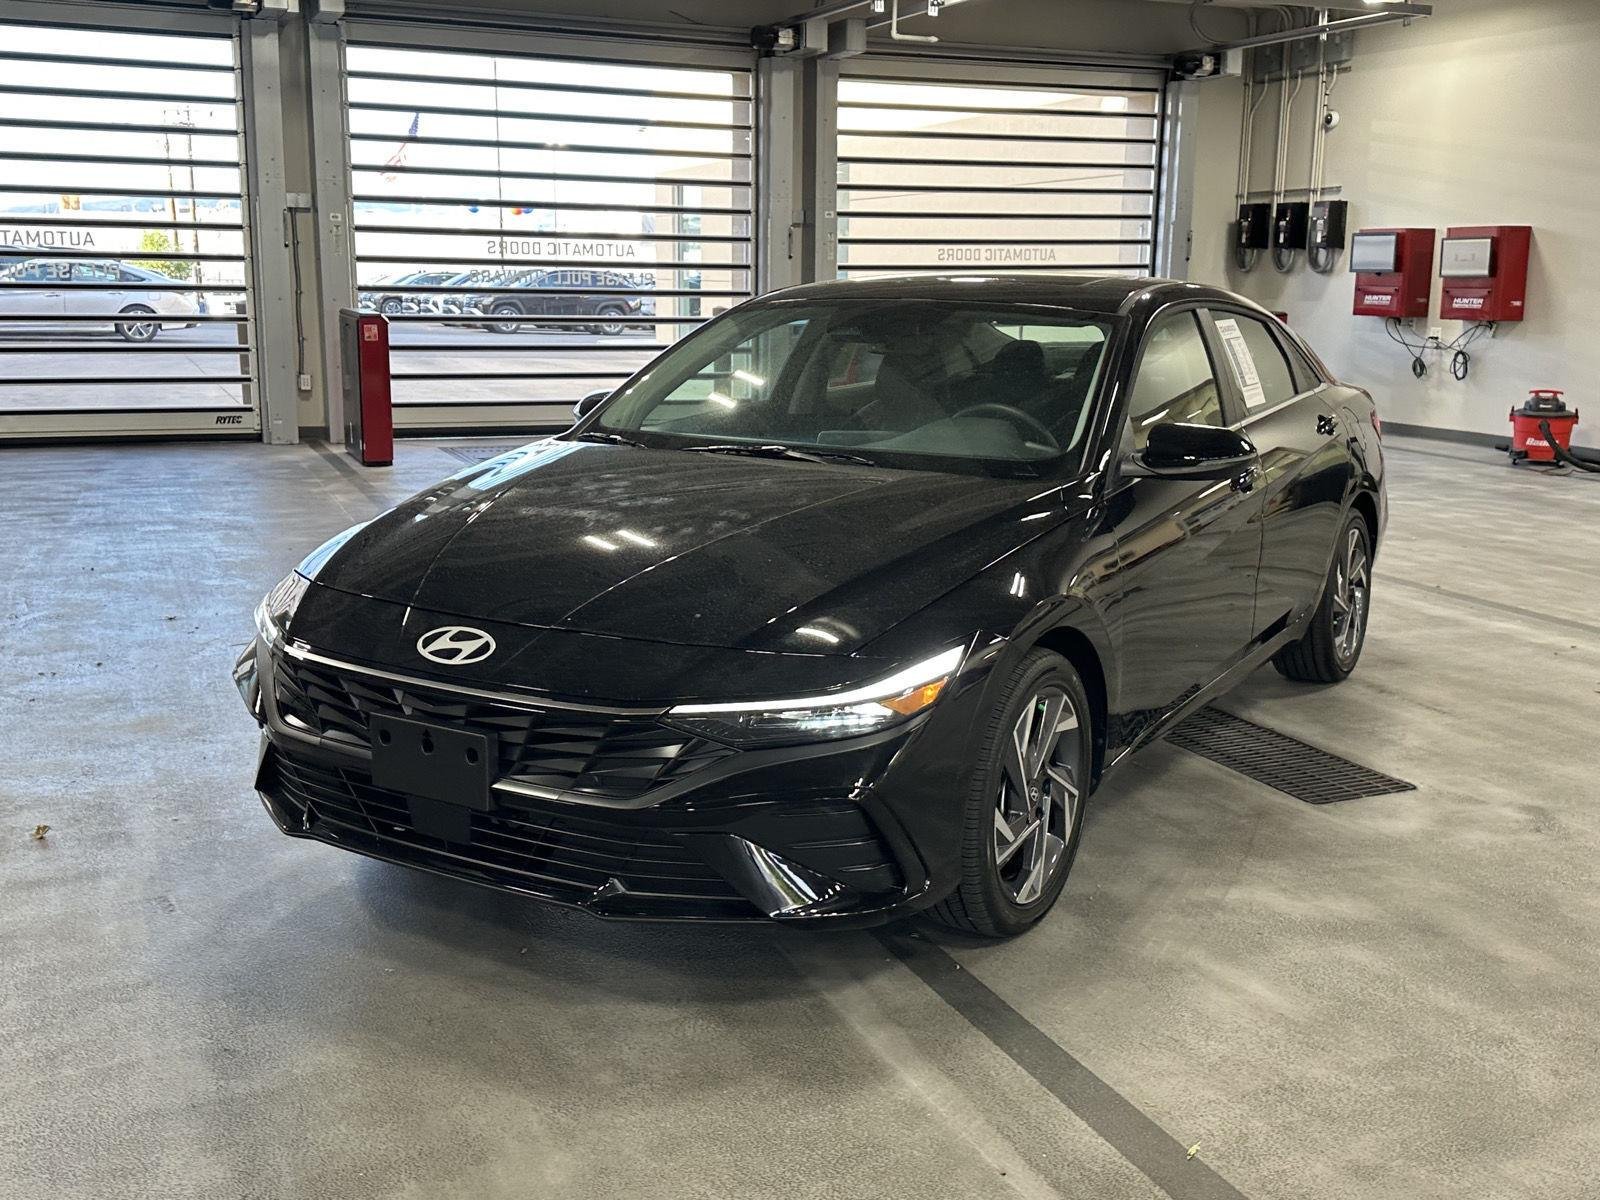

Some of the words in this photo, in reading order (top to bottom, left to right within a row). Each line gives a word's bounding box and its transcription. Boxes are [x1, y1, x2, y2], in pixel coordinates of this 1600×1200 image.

[1364, 294, 1392, 302] HUNTER
[1453, 297, 1484, 305] HUNTER
[215, 415, 243, 424] RYTEC
